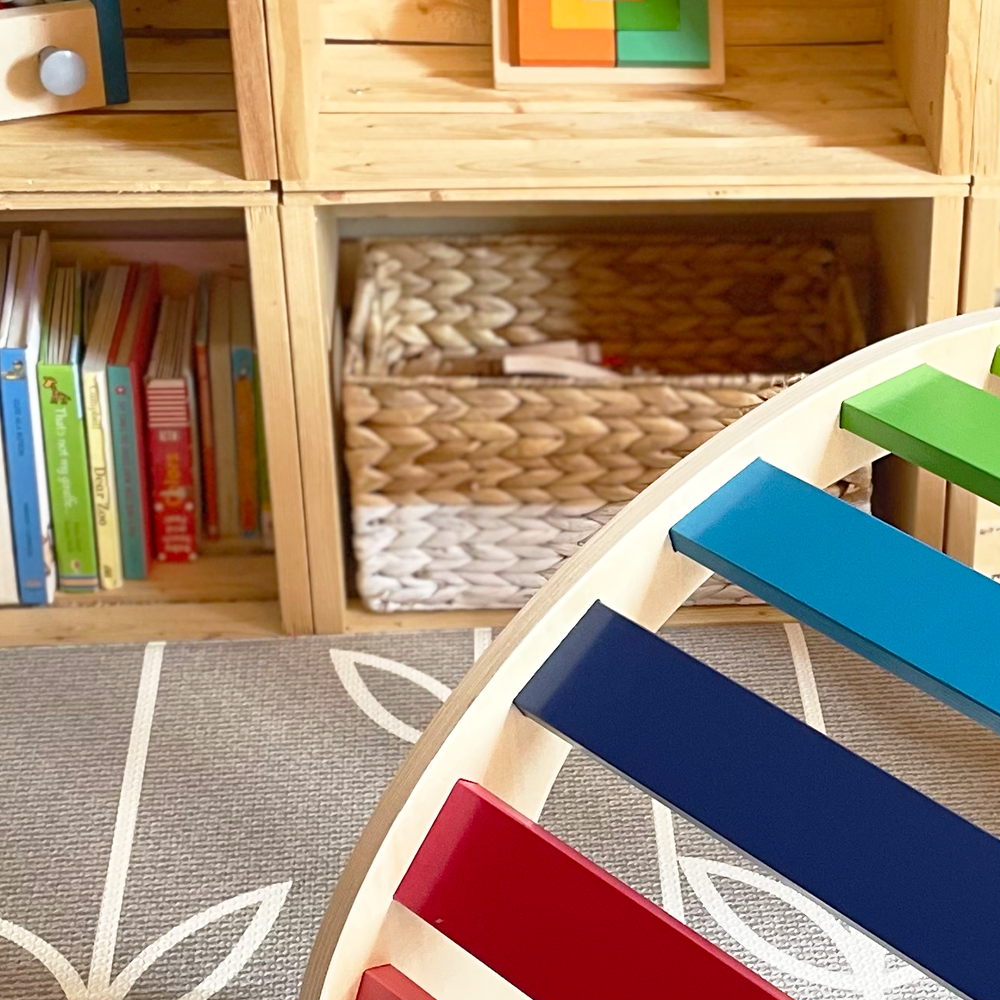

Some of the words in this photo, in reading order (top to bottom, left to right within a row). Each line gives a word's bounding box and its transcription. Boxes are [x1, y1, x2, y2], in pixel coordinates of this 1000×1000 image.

[57, 439, 69, 455] not
[57, 459, 68, 474] my
[94, 467, 106, 499] Dear
[97, 503, 109, 526] Zoo
